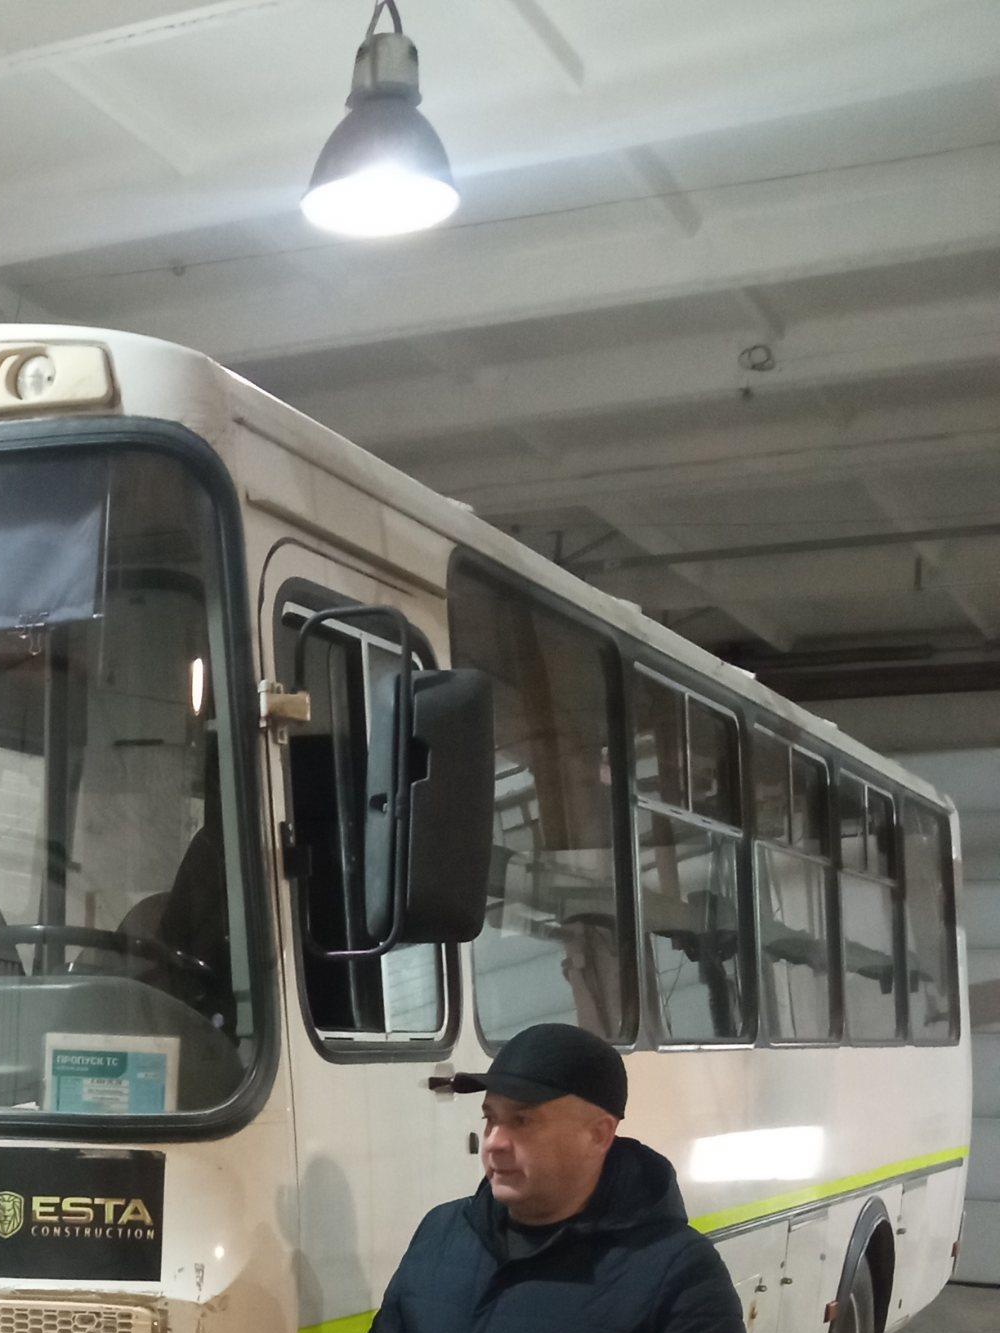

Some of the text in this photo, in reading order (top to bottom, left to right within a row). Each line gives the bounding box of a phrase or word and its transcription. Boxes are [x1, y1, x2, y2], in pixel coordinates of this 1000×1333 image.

[56, 1055, 119, 1067] ПРОПУСК ТС
[31, 1195, 154, 1226] ESTA
[30, 1225, 155, 1240] CONSTRUCTION
